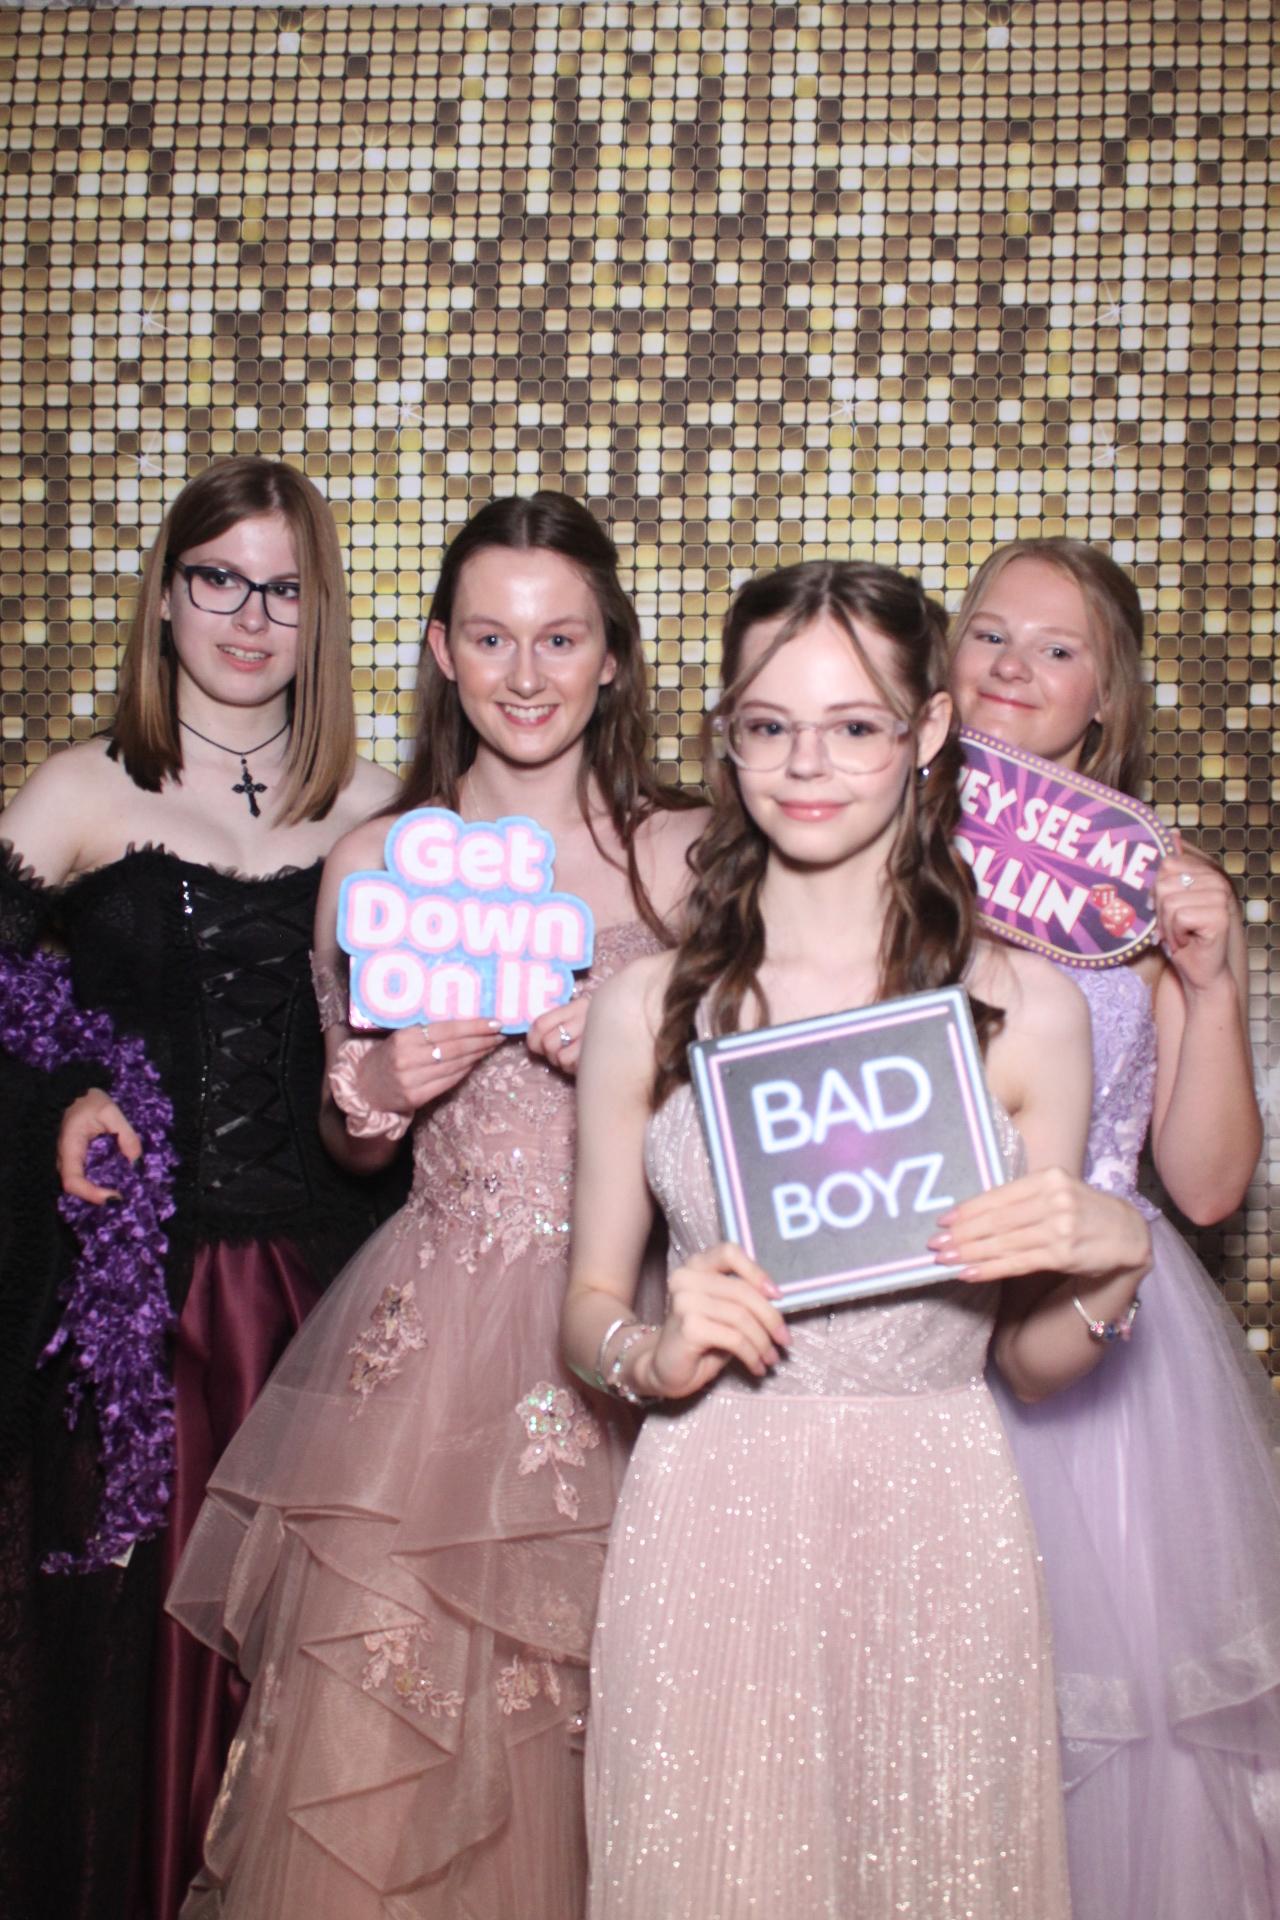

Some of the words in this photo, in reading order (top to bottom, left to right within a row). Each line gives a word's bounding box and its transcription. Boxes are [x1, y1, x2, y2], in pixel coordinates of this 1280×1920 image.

[397, 818, 544, 892] Get
[956, 766, 1018, 825] EY
[1016, 798, 1091, 860] SEE
[1086, 830, 1158, 890] ME
[349, 881, 586, 960] Down
[363, 952, 480, 1018] On
[497, 959, 563, 1024] It
[752, 1055, 932, 1154] BAD
[772, 1153, 955, 1240] BOYZ
